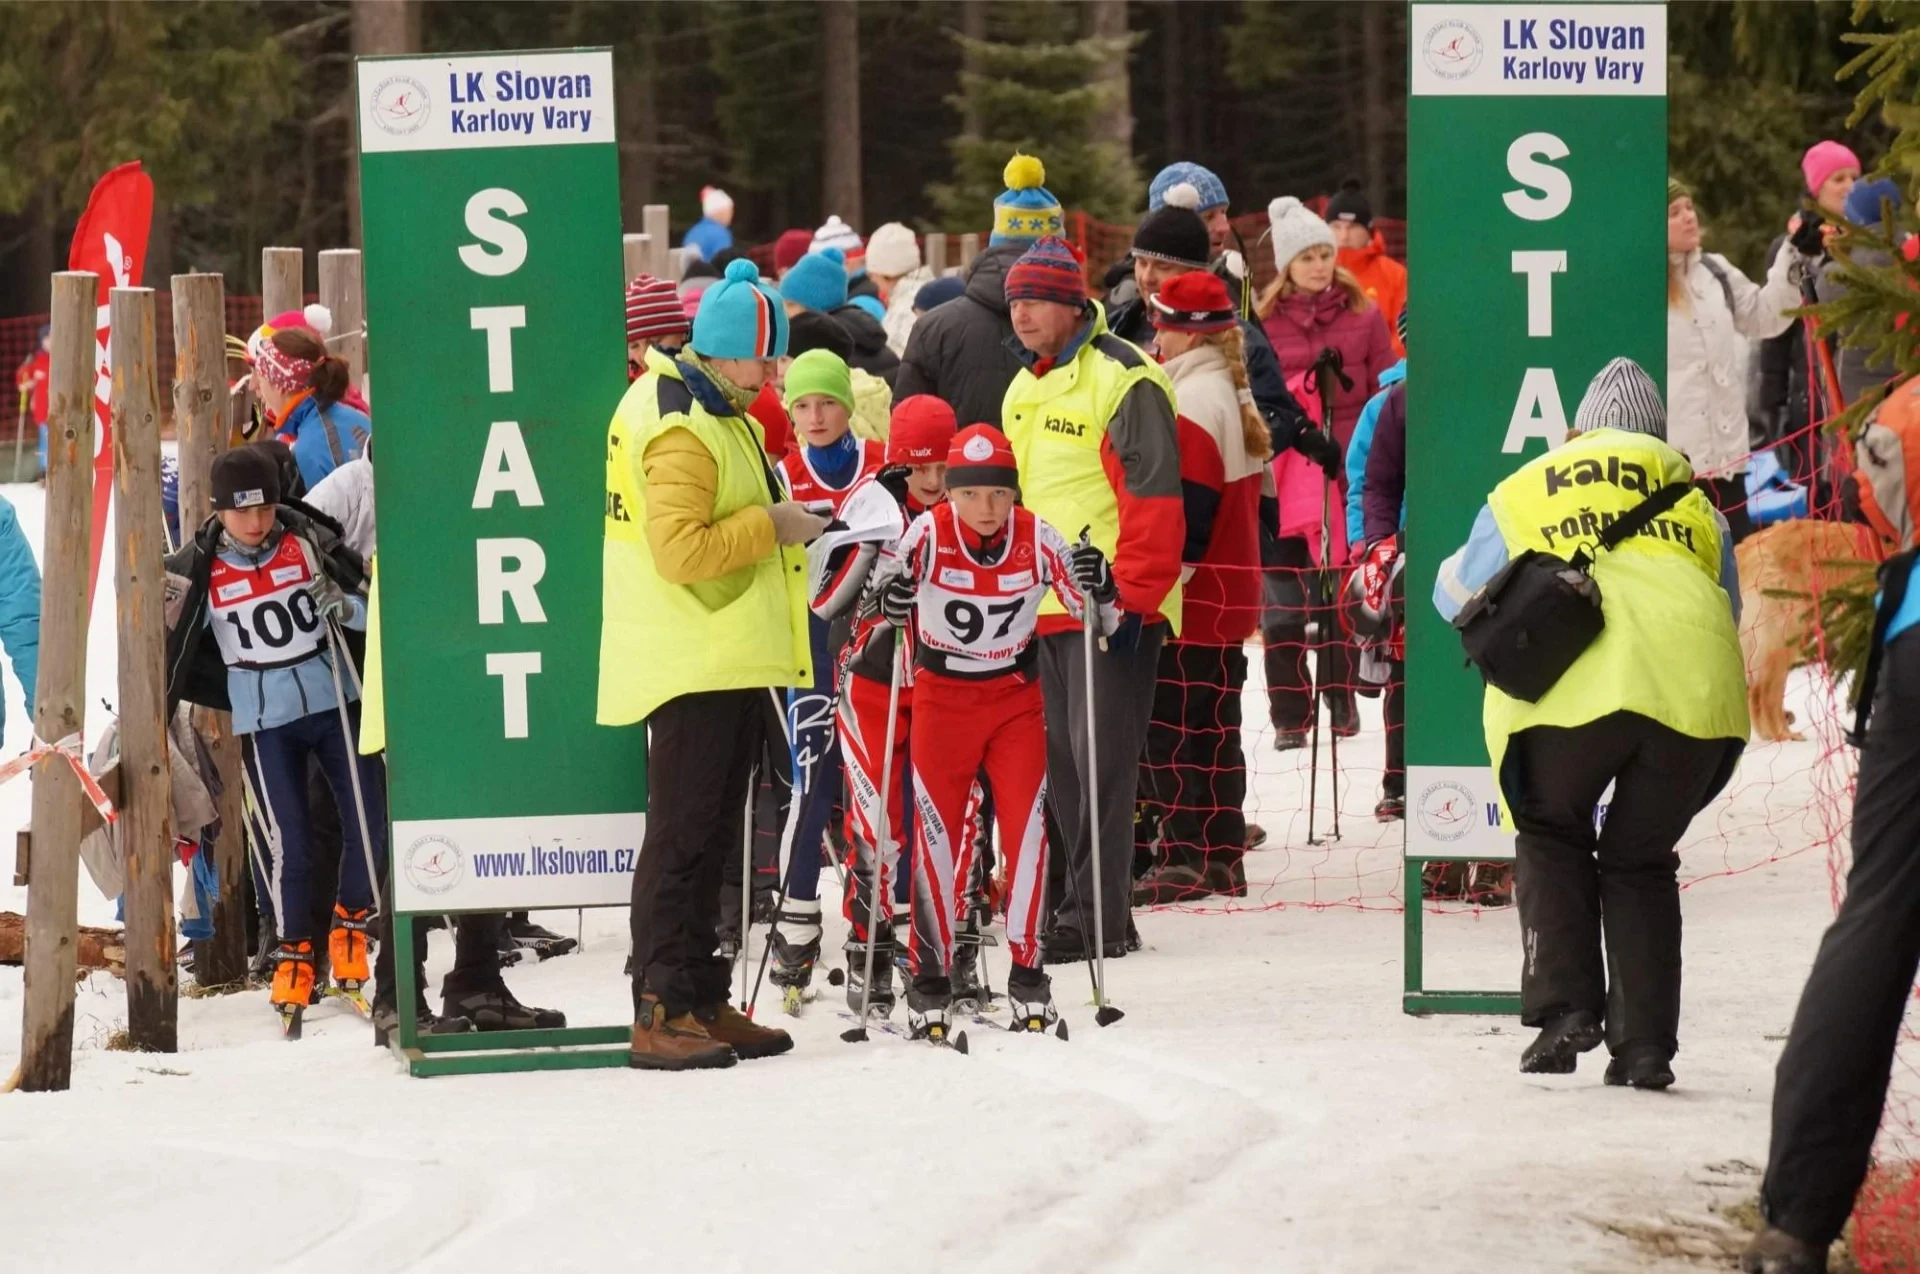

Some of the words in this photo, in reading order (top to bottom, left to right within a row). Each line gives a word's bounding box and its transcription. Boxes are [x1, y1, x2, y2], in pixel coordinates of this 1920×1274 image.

[1503, 19, 1538, 50] LK
[1549, 18, 1645, 50] Slovan
[1503, 56, 1587, 84] Karlovy
[1595, 56, 1645, 84] Vary
[450, 72, 485, 103] LK
[495, 70, 592, 102] Slovan
[451, 109, 534, 135] Karlovy
[542, 106, 592, 132] Vary
[1501, 131, 1573, 454] STA
[1043, 414, 1086, 437] kalas
[458, 187, 549, 739] START
[1545, 456, 1662, 500] kala
[226, 588, 320, 650] 100
[944, 596, 1026, 645] 97
[856, 769, 876, 798] SLOVAN
[925, 804, 945, 835] SLOVAN
[473, 845, 636, 877] www.lkslovan.cz
